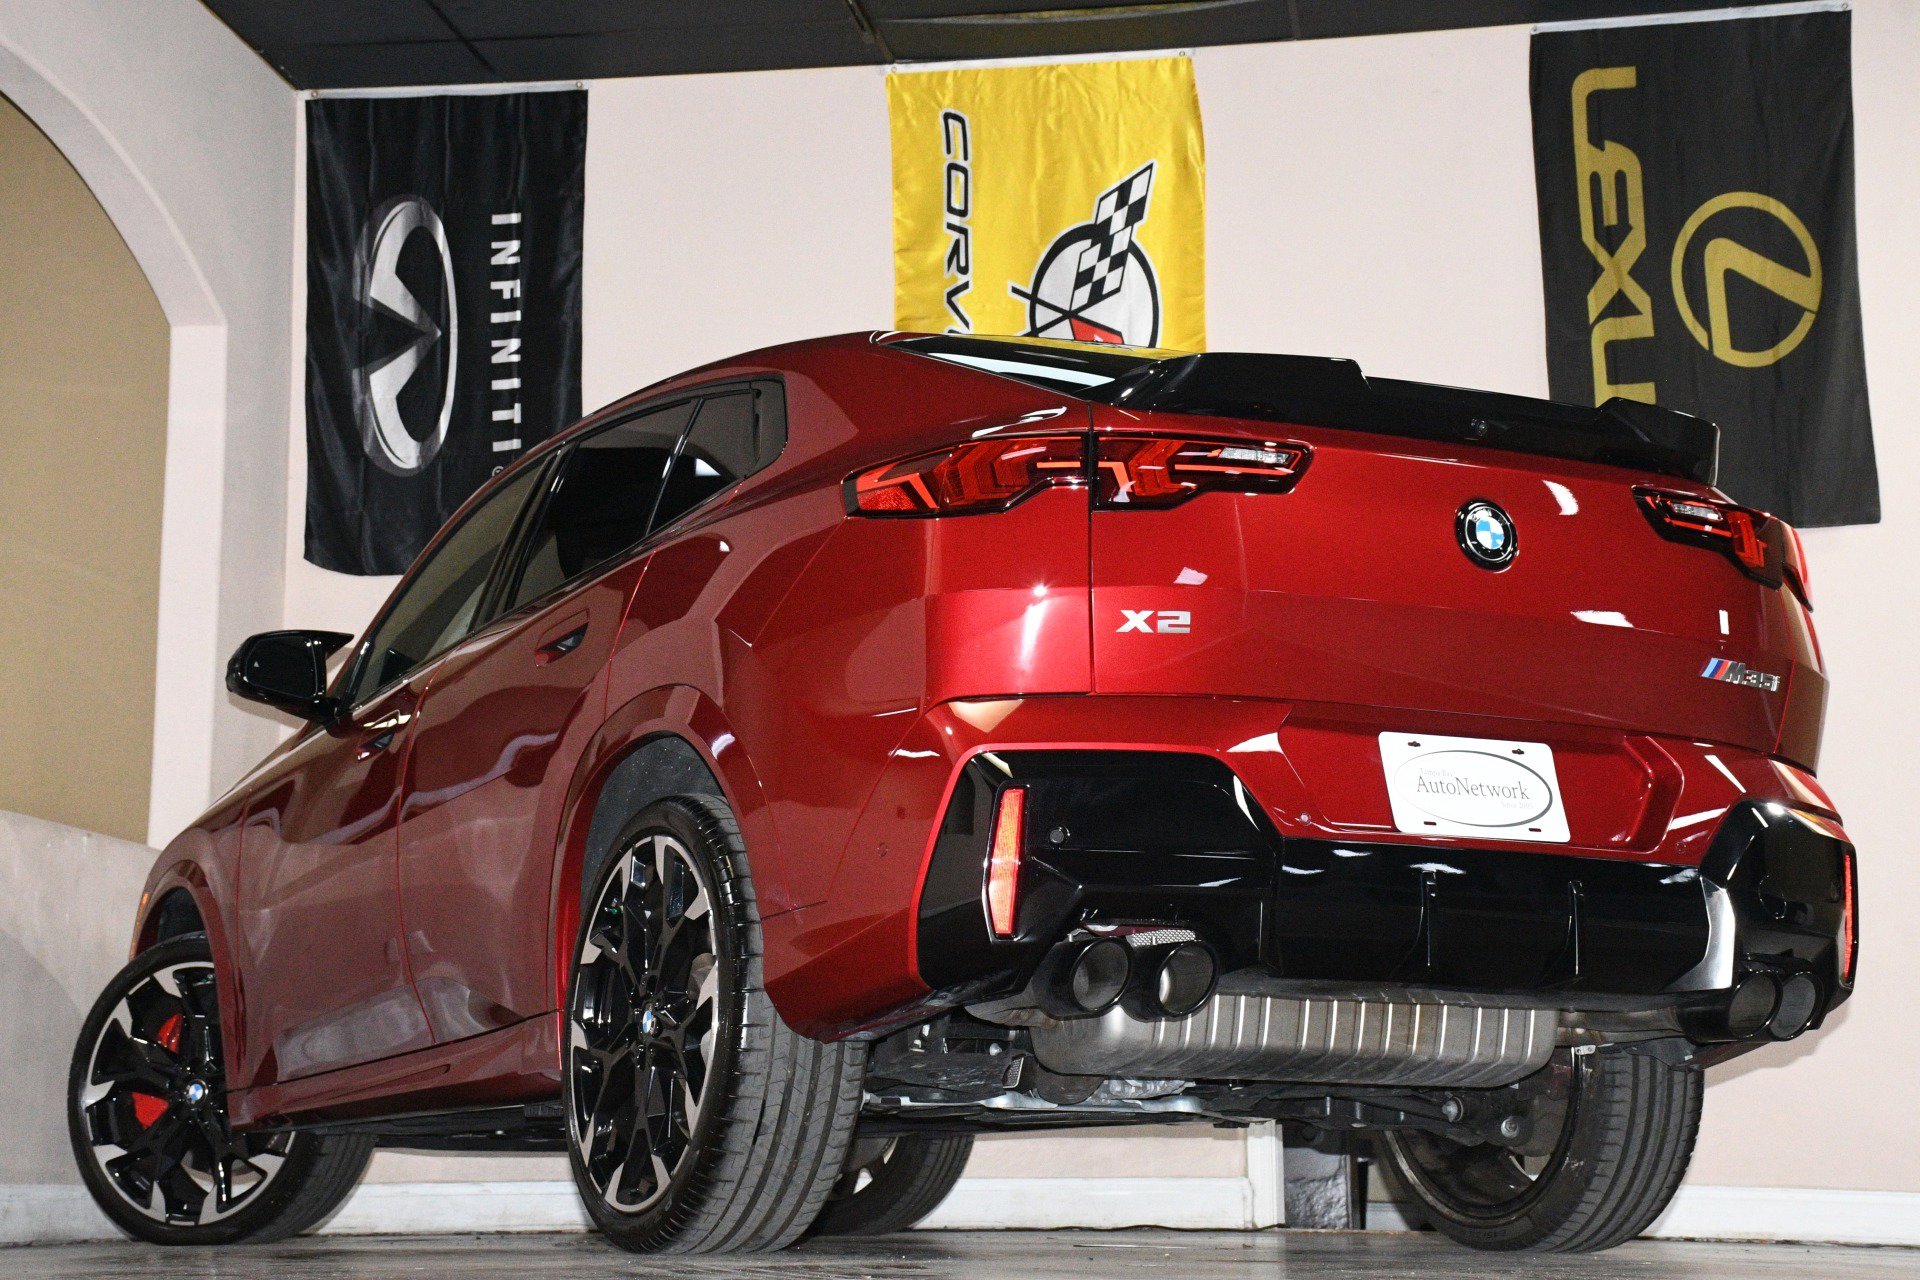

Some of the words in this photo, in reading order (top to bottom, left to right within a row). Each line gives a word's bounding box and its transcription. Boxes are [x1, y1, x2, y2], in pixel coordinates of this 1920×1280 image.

[491, 213, 522, 452] INFINITI
[1115, 609, 1191, 633] X2
[1416, 774, 1531, 801] AutoNetwork
